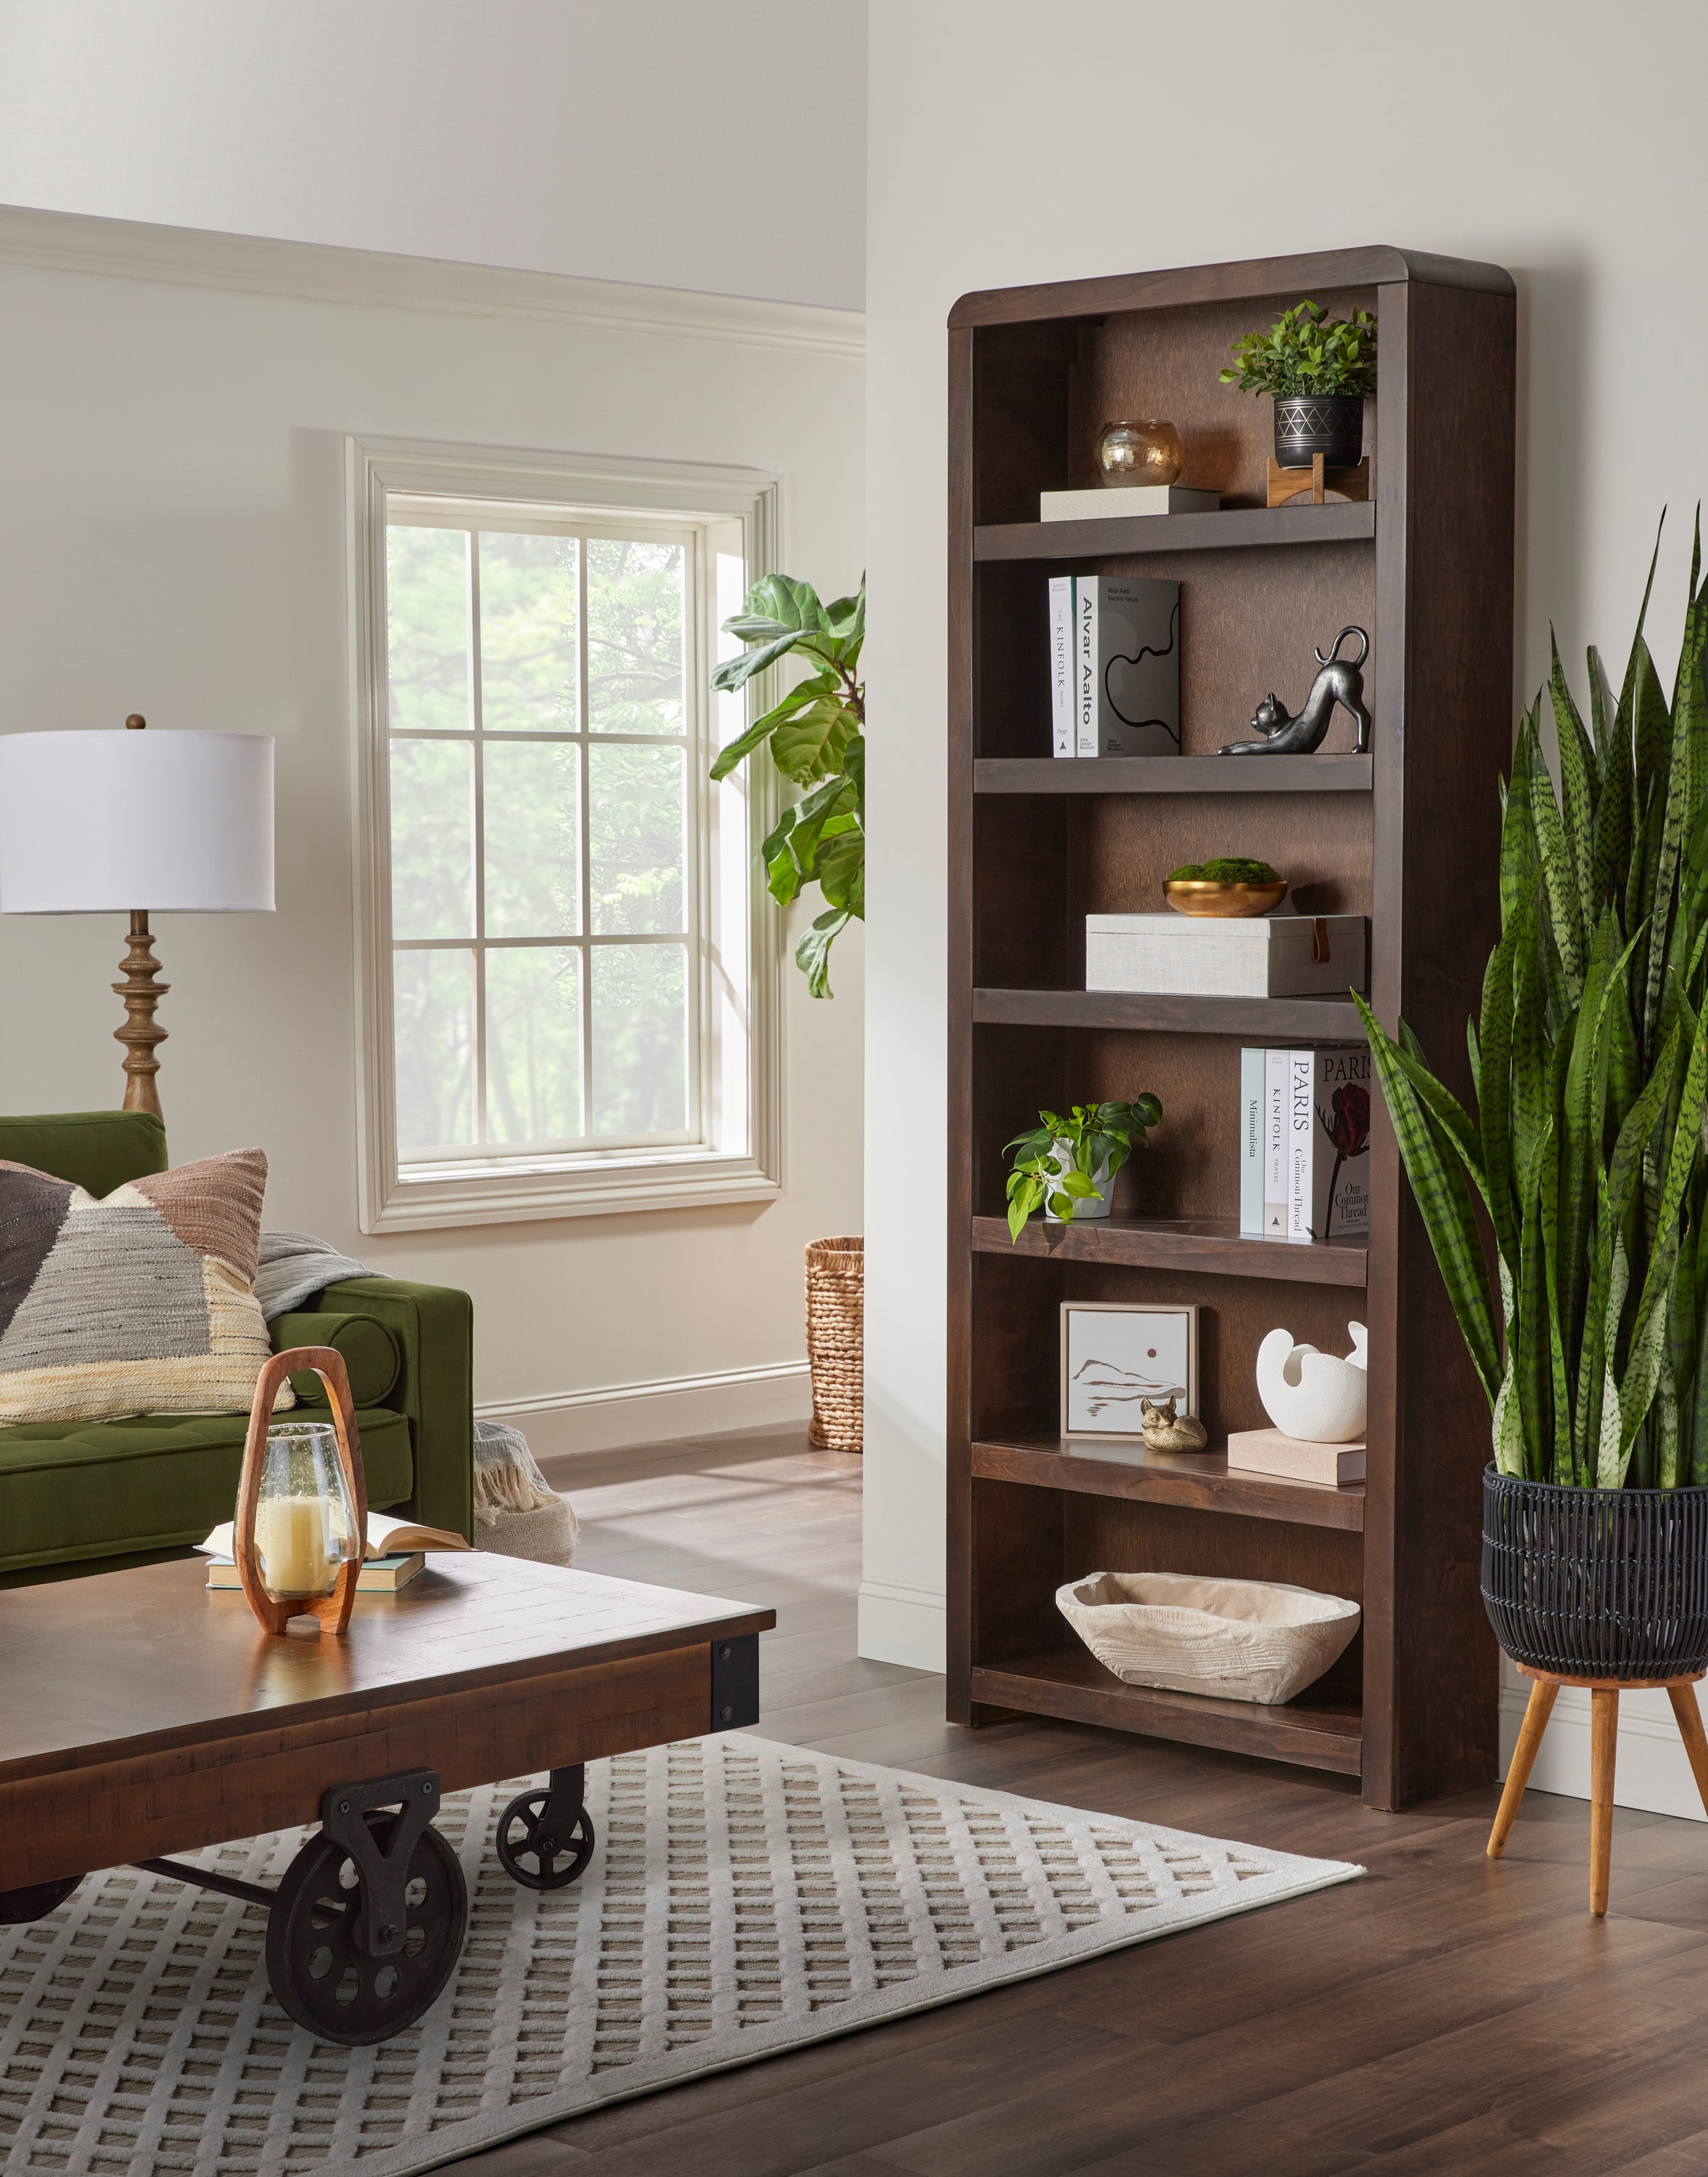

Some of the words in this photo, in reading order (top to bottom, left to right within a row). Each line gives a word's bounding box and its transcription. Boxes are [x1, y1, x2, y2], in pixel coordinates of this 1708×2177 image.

[1056, 626, 1065, 687] KINFOLK
[1083, 596, 1093, 658] Alvar
[1083, 665, 1092, 726] Aalto
[1294, 1060, 1310, 1131] PARIS
[1249, 1099, 1257, 1158] Minimalista
[1294, 1149, 1303, 1194] Common
[1345, 1182, 1361, 1196] Our
[1294, 1196, 1303, 1231] Thread
[1339, 1203, 1367, 1219] Thread
